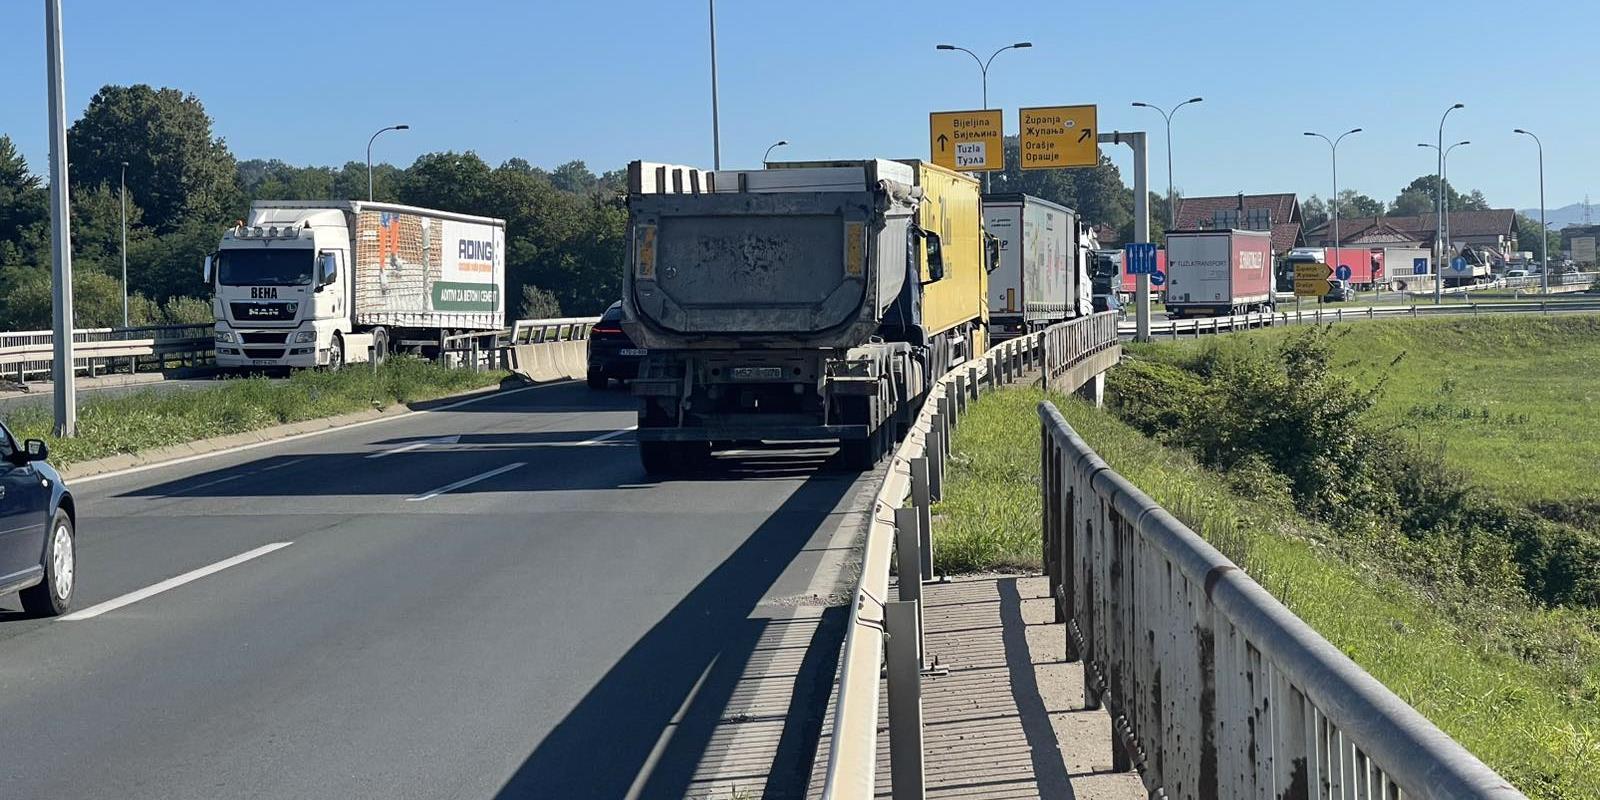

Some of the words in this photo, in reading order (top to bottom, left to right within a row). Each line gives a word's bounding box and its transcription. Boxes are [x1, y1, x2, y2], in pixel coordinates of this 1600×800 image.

[953, 118, 990, 129] Bijeljina
[1025, 114, 1060, 125] Županja
[953, 130, 997, 140] Бијељина
[1026, 128, 1064, 137] Жупања
[957, 144, 980, 153] Tuzla
[1025, 141, 1055, 150] Orašje
[957, 156, 984, 166] Тузла
[1025, 153, 1060, 162] Орашје
[458, 239, 492, 260] ADING
[251, 287, 278, 299] BEHA
